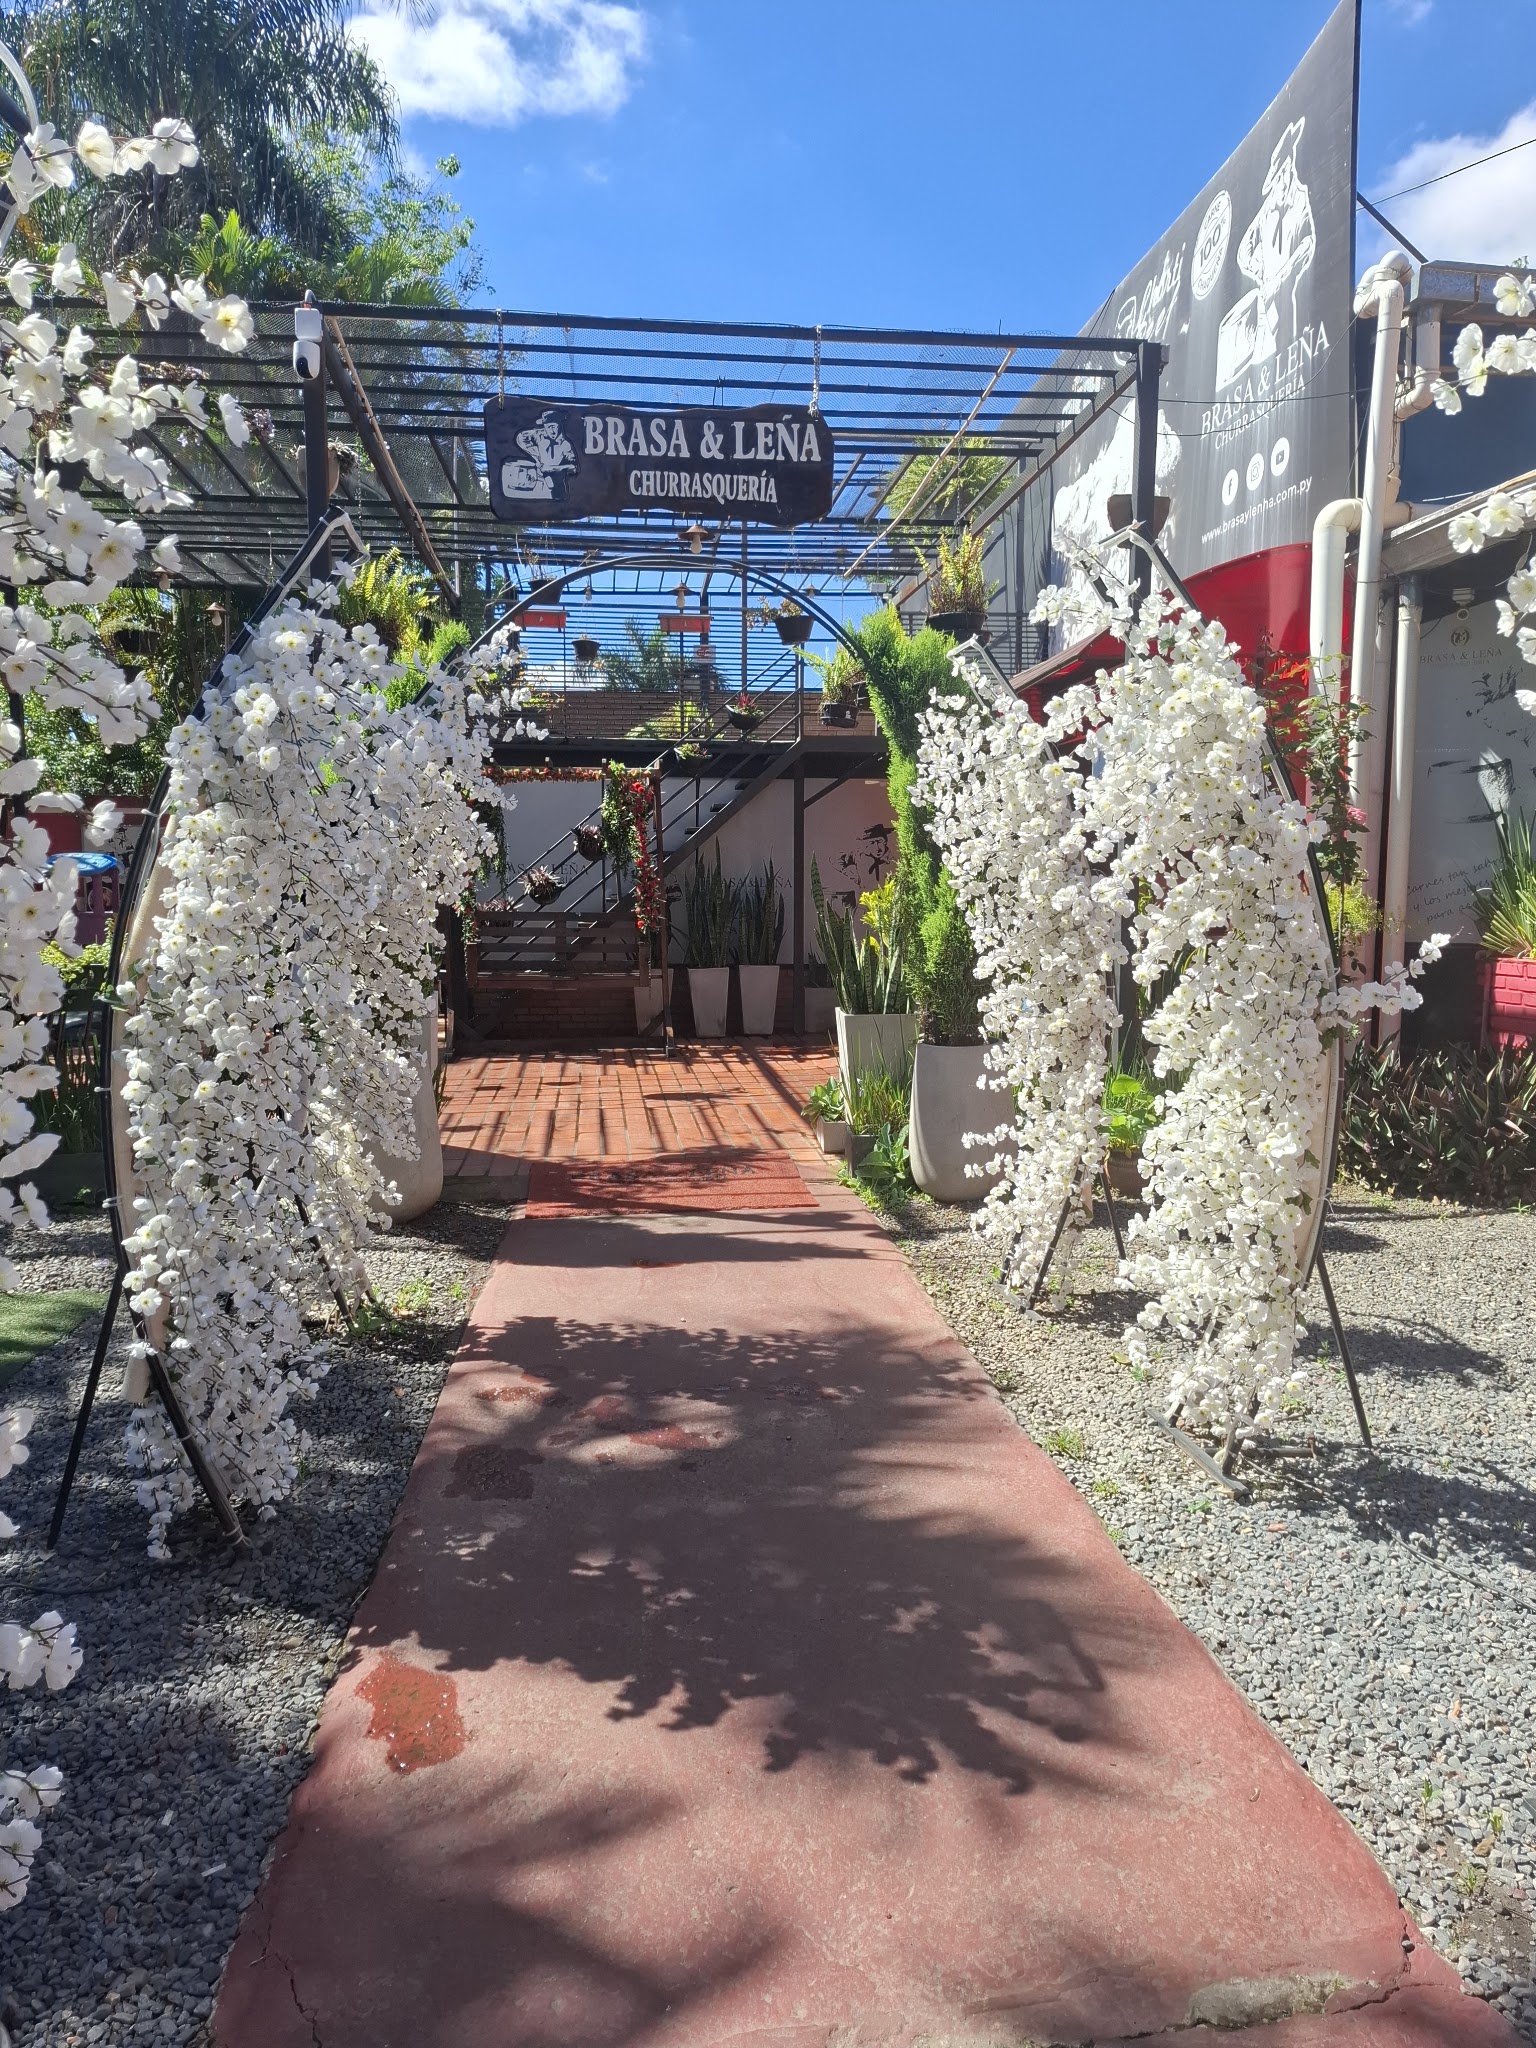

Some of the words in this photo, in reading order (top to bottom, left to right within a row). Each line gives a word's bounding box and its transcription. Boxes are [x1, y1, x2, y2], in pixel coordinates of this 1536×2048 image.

[1200, 377, 1254, 440] BRASA
[1257, 365, 1271, 397] &
[1274, 321, 1330, 385] LEÑA
[1215, 373, 1306, 450] CHURRASQUERÍA
[583, 416, 690, 457] BRASA
[700, 420, 726, 459] &
[732, 414, 822, 463] LEÑA
[629, 469, 778, 505] CHURRASQUERÍA
[1201, 476, 1313, 544] www.brasaylenha.com.py
[1420, 653, 1456, 664] BRASA
[1460, 651, 1468, 660] &
[1472, 647, 1502, 659] LEÑA
[1448, 870, 1469, 882] tan
[1424, 896, 1441, 906] los
[1426, 908, 1454, 924] para
